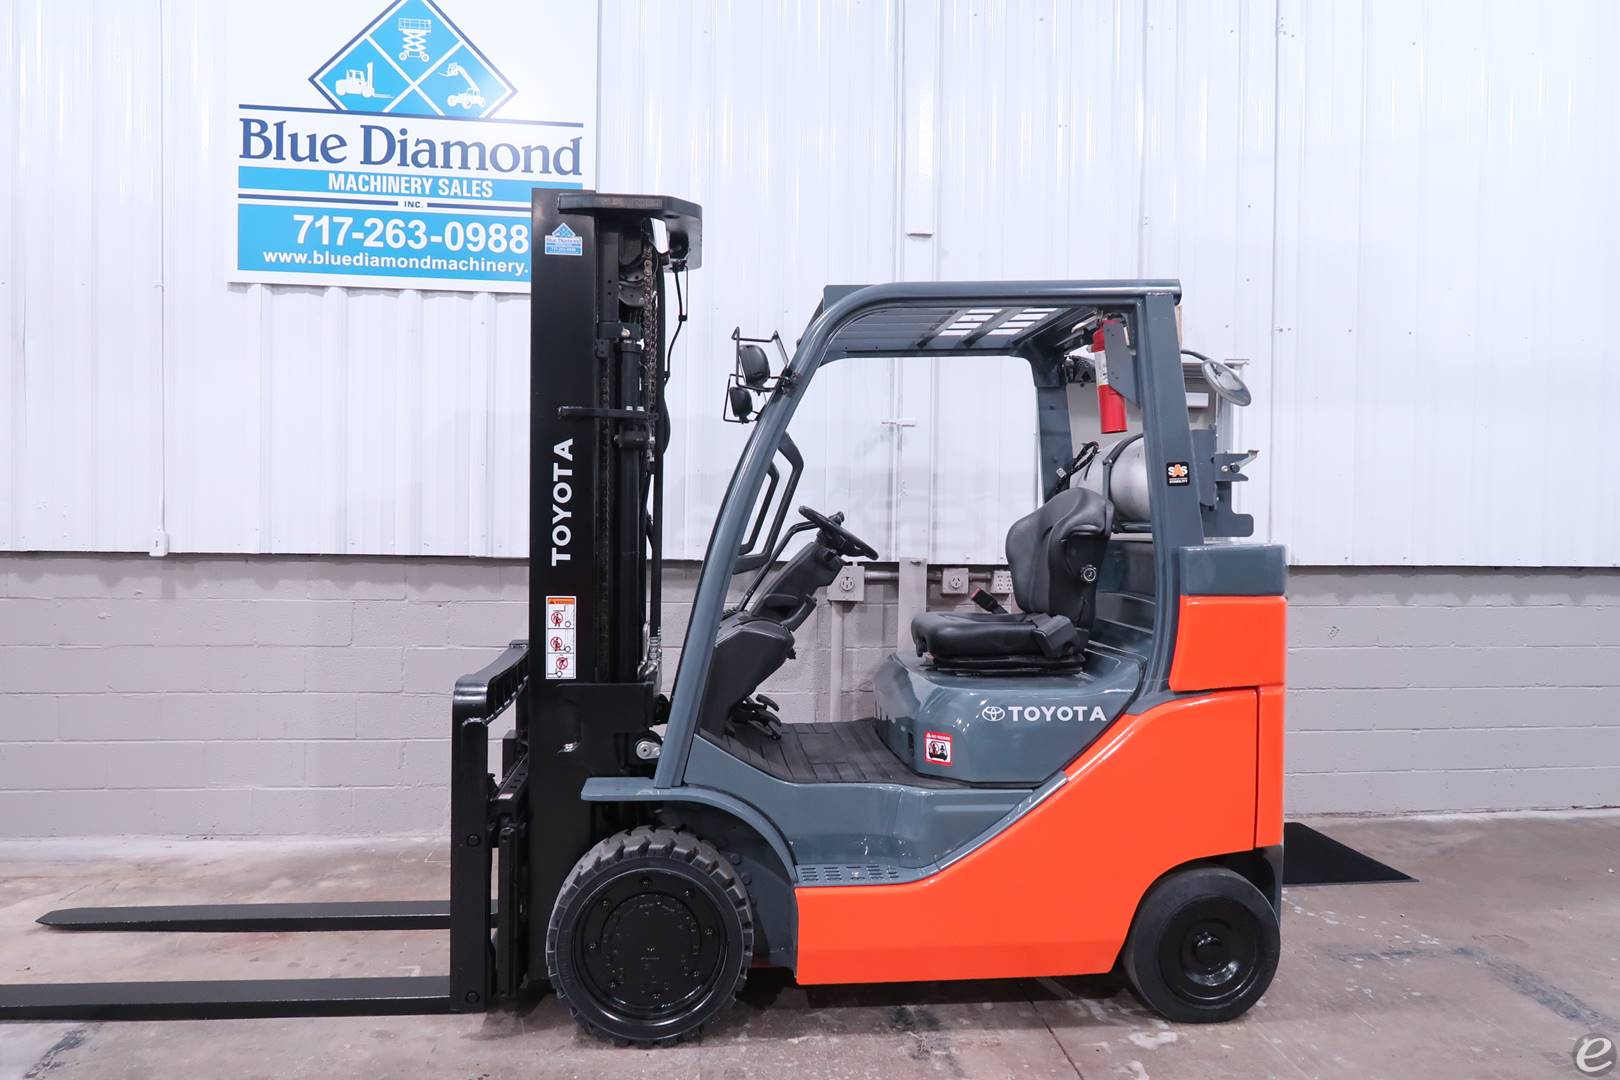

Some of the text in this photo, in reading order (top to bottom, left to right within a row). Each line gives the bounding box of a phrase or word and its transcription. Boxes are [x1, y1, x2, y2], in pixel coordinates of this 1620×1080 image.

[239, 118, 582, 175] Blue Diamond
[329, 173, 493, 198] MACHINERY SALES
[293, 214, 529, 254] 717-263-0988
[1168, 464, 1188, 477] SAS
[551, 438, 574, 566] TOYOTA
[1008, 706, 1107, 722] TOYOTA
